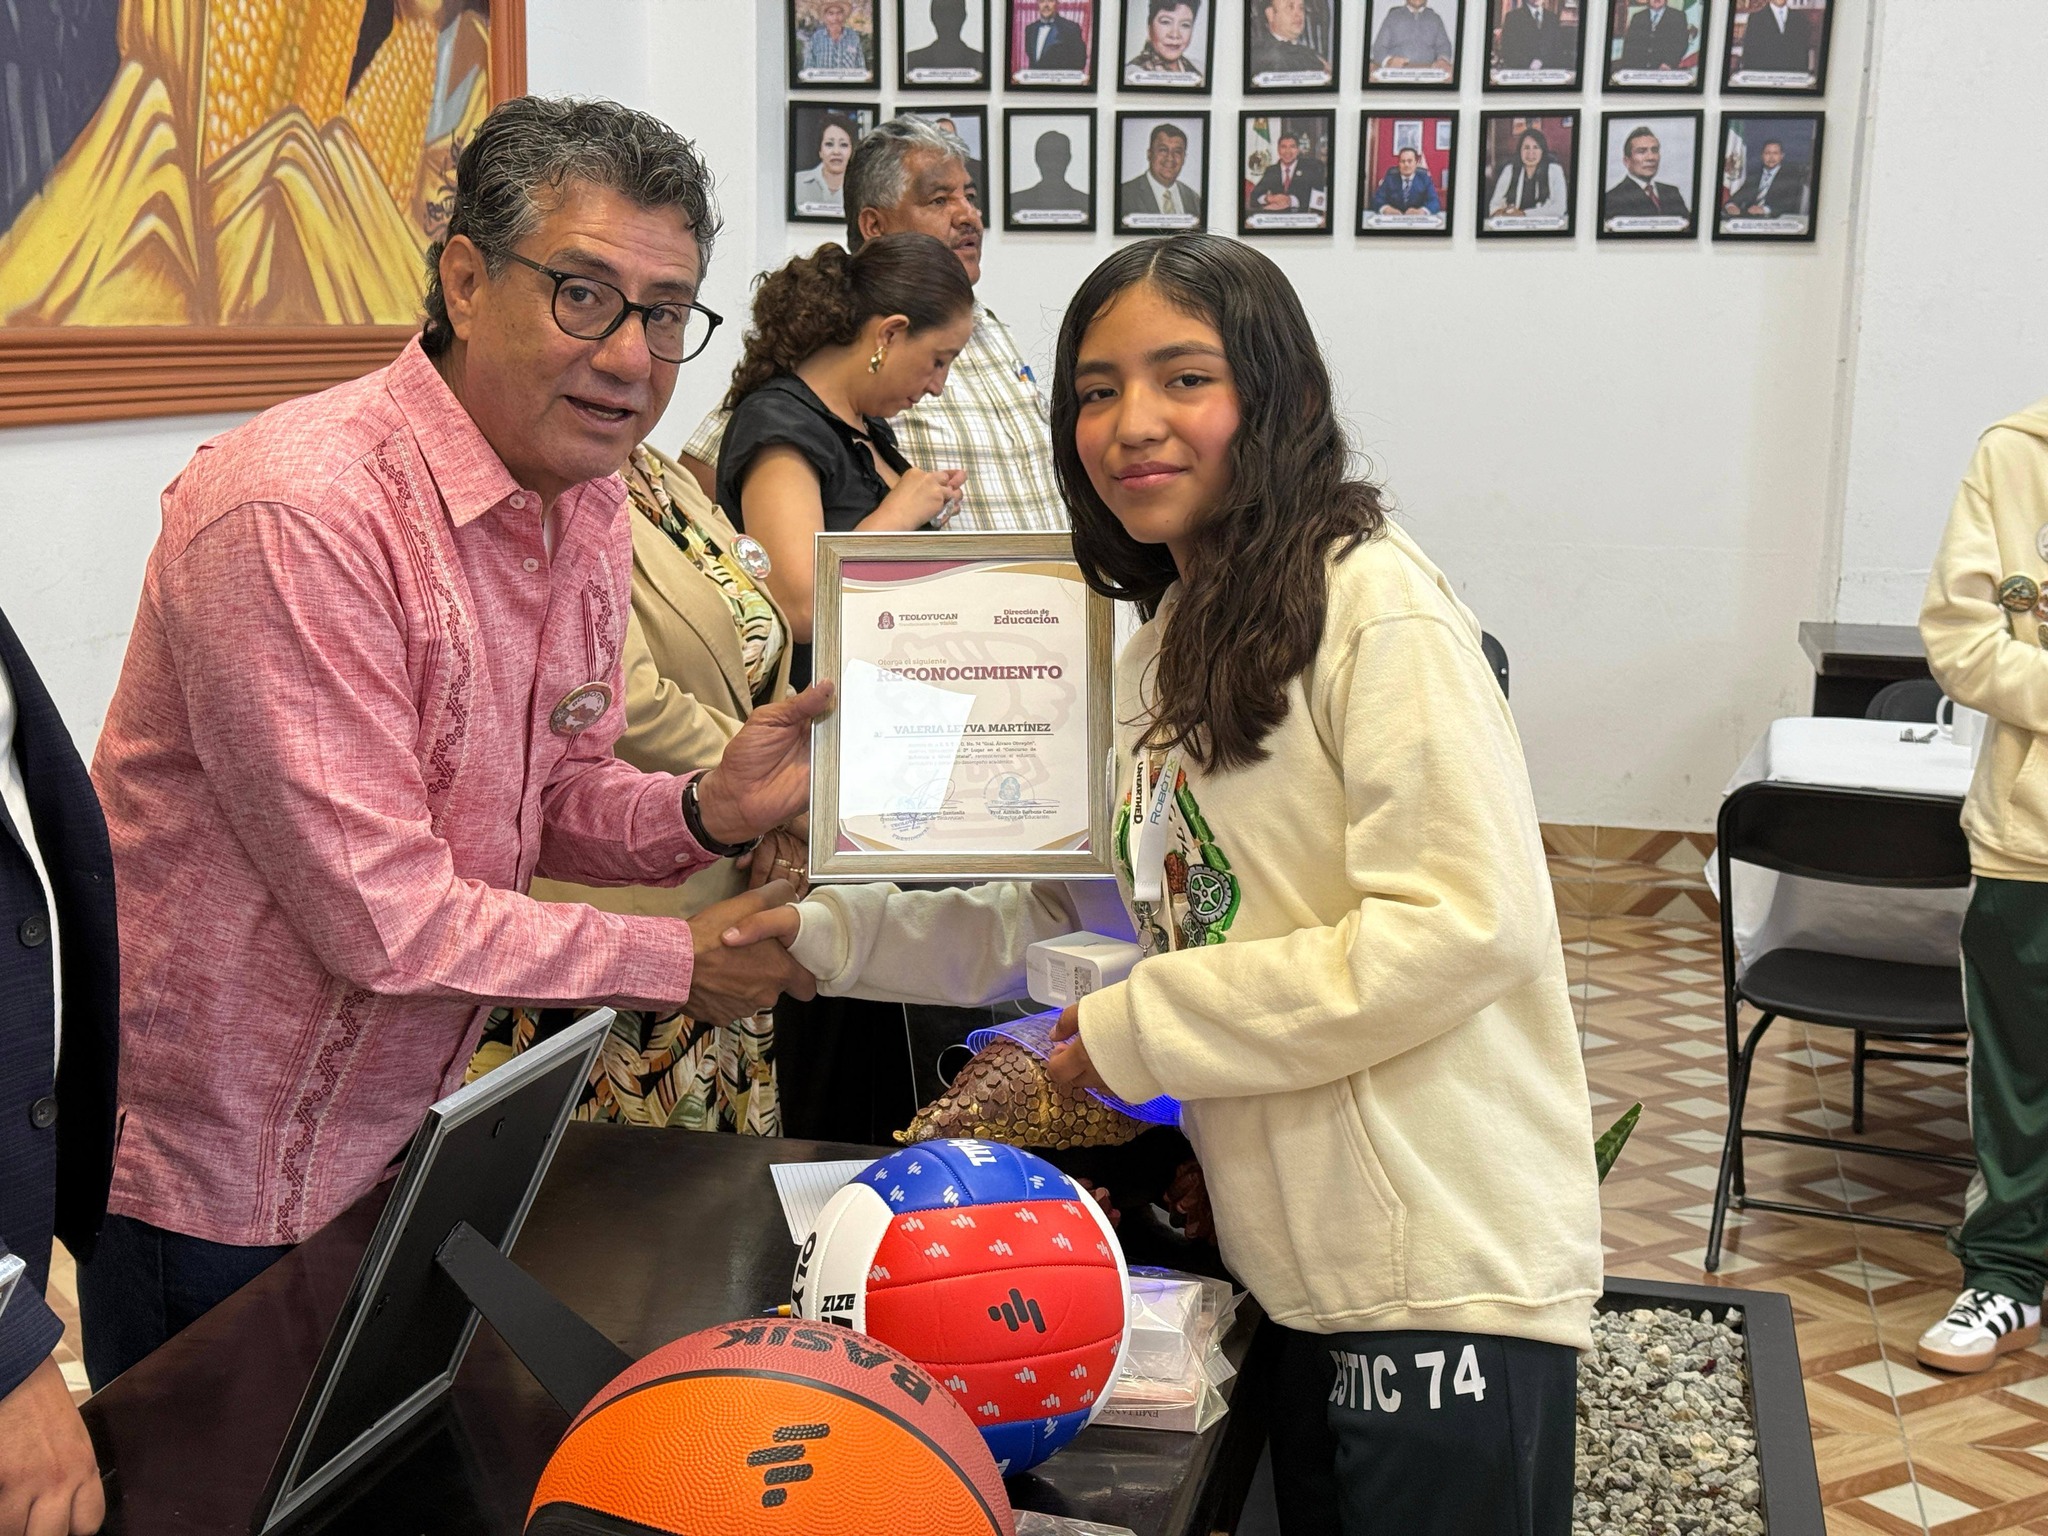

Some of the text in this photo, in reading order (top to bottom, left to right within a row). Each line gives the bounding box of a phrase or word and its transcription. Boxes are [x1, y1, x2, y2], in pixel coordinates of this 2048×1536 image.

[899, 613, 958, 621] TEOLOYUCAN
[993, 613, 1059, 625] Educación
[1003, 608, 1050, 616] Dirección de
[878, 658, 946, 667] Otorga el siguiente
[877, 665, 1062, 682] RECONOCIMIENTO
[894, 725, 944, 735] VALERIA
[947, 723, 985, 733] LEYVA
[988, 721, 1051, 732] MARTÍNEZ
[1133, 761, 1144, 825] UNEARTHED
[1149, 758, 1176, 825] ROBOTIX
[713, 1326, 932, 1406] BASIK
[1414, 1344, 1487, 1410] 74
